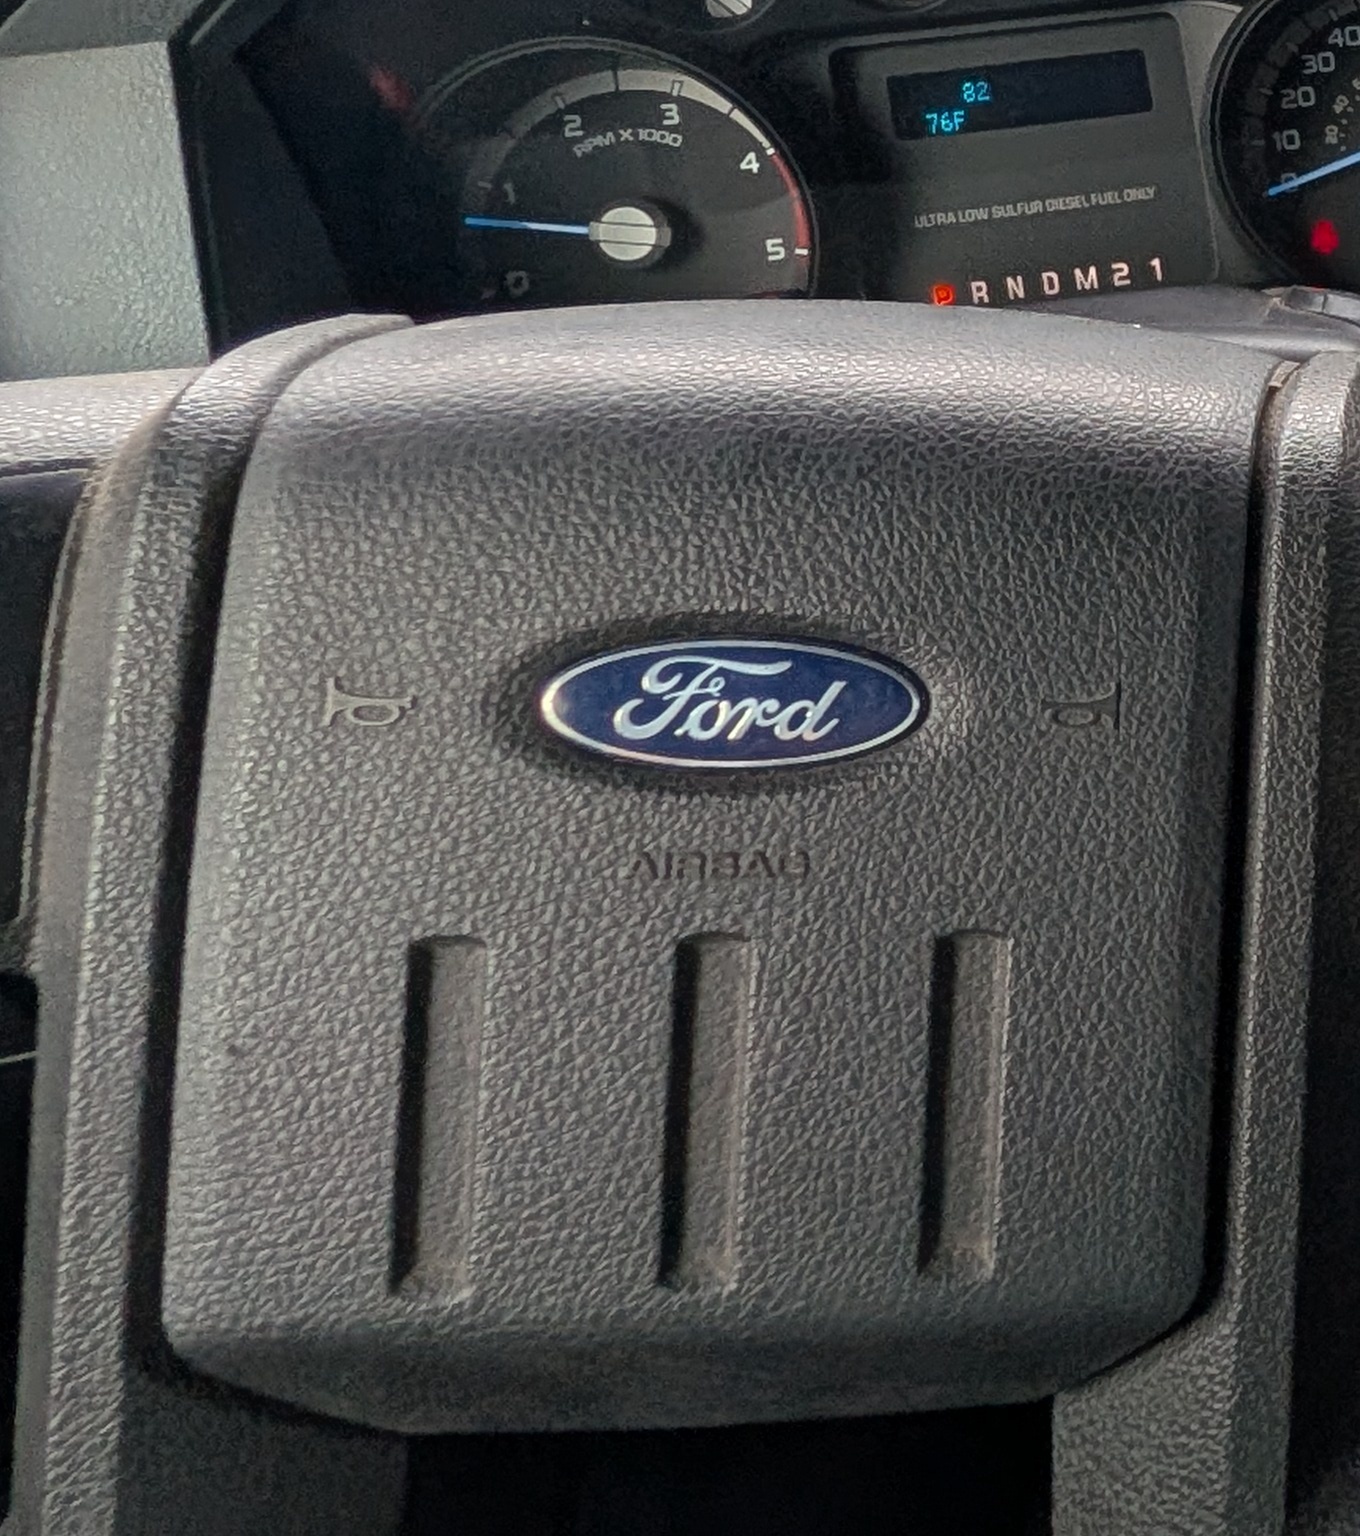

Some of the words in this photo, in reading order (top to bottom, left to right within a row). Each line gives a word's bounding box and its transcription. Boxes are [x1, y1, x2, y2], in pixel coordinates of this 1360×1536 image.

[1301, 51, 1335, 74] 30
[962, 81, 991, 102] 82
[1280, 86, 1316, 109] 20
[660, 103, 679, 125] 3
[926, 111, 965, 134] 76F
[563, 115, 583, 137] 2
[573, 132, 615, 158] RPM
[638, 128, 683, 148] 1000
[1272, 129, 1300, 152] 10
[740, 152, 760, 173] 4
[915, 212, 956, 228] ULTRA
[958, 207, 989, 223] LOW
[992, 199, 1043, 219] SULFUR
[1046, 195, 1089, 212] DIESEL
[1091, 190, 1122, 207] FUEL
[1123, 186, 1156, 202] ONLY
[765, 238, 785, 261] 5
[933, 285, 954, 305] P
[971, 281, 990, 304] R
[1006, 275, 1025, 300] N
[1042, 272, 1060, 295] D
[1074, 266, 1099, 290] M
[1111, 263, 1131, 286] 2
[1150, 257, 1162, 282] 1
[613, 655, 848, 741] Ford
[628, 850, 812, 880] AIRBAG
